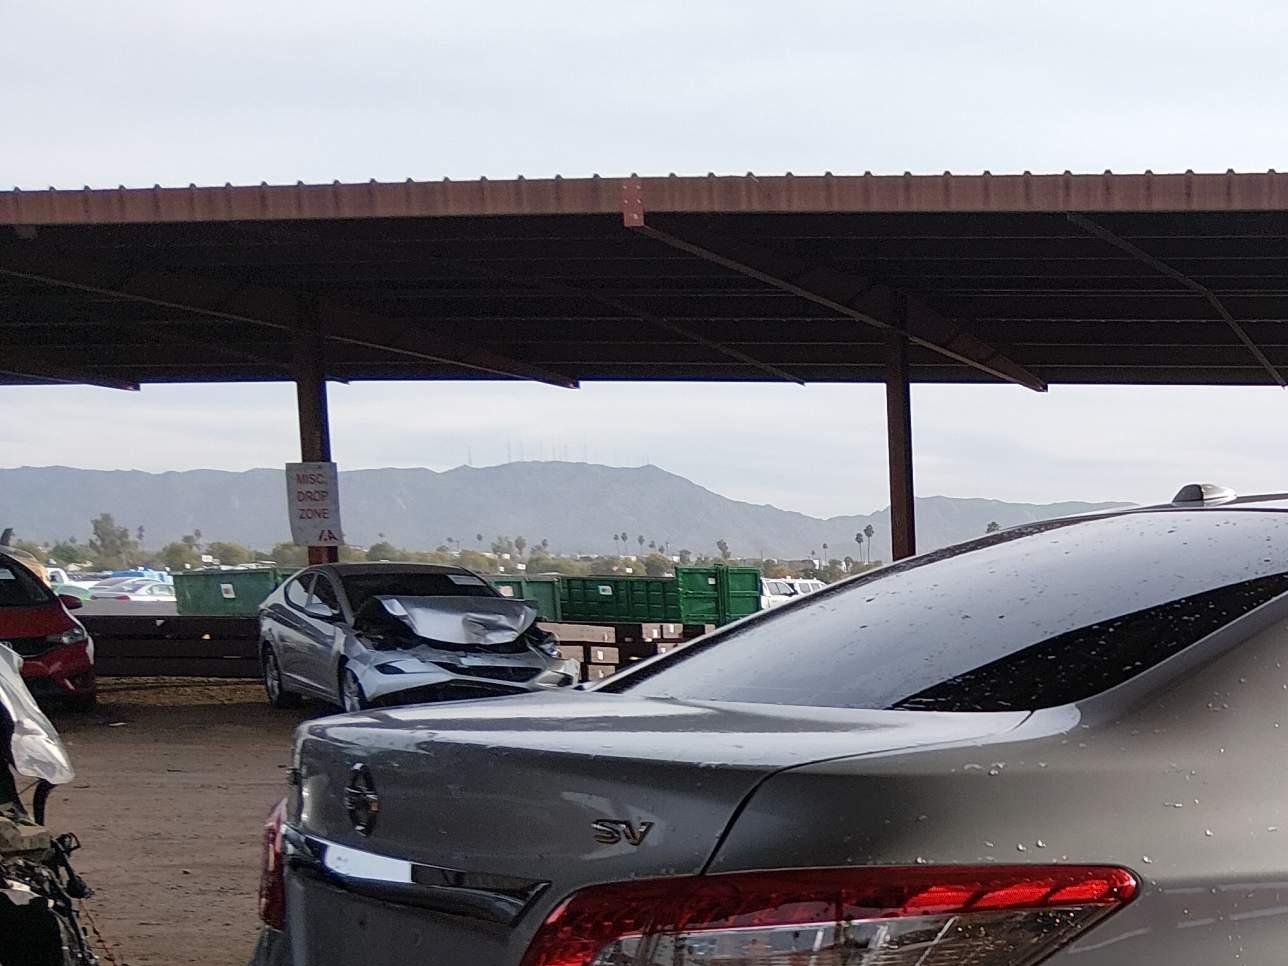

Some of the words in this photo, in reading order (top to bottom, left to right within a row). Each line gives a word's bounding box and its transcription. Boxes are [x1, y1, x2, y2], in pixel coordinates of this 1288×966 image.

[297, 490, 329, 502] DROP
[298, 508, 330, 520] ZONE
[592, 819, 655, 846] SV
